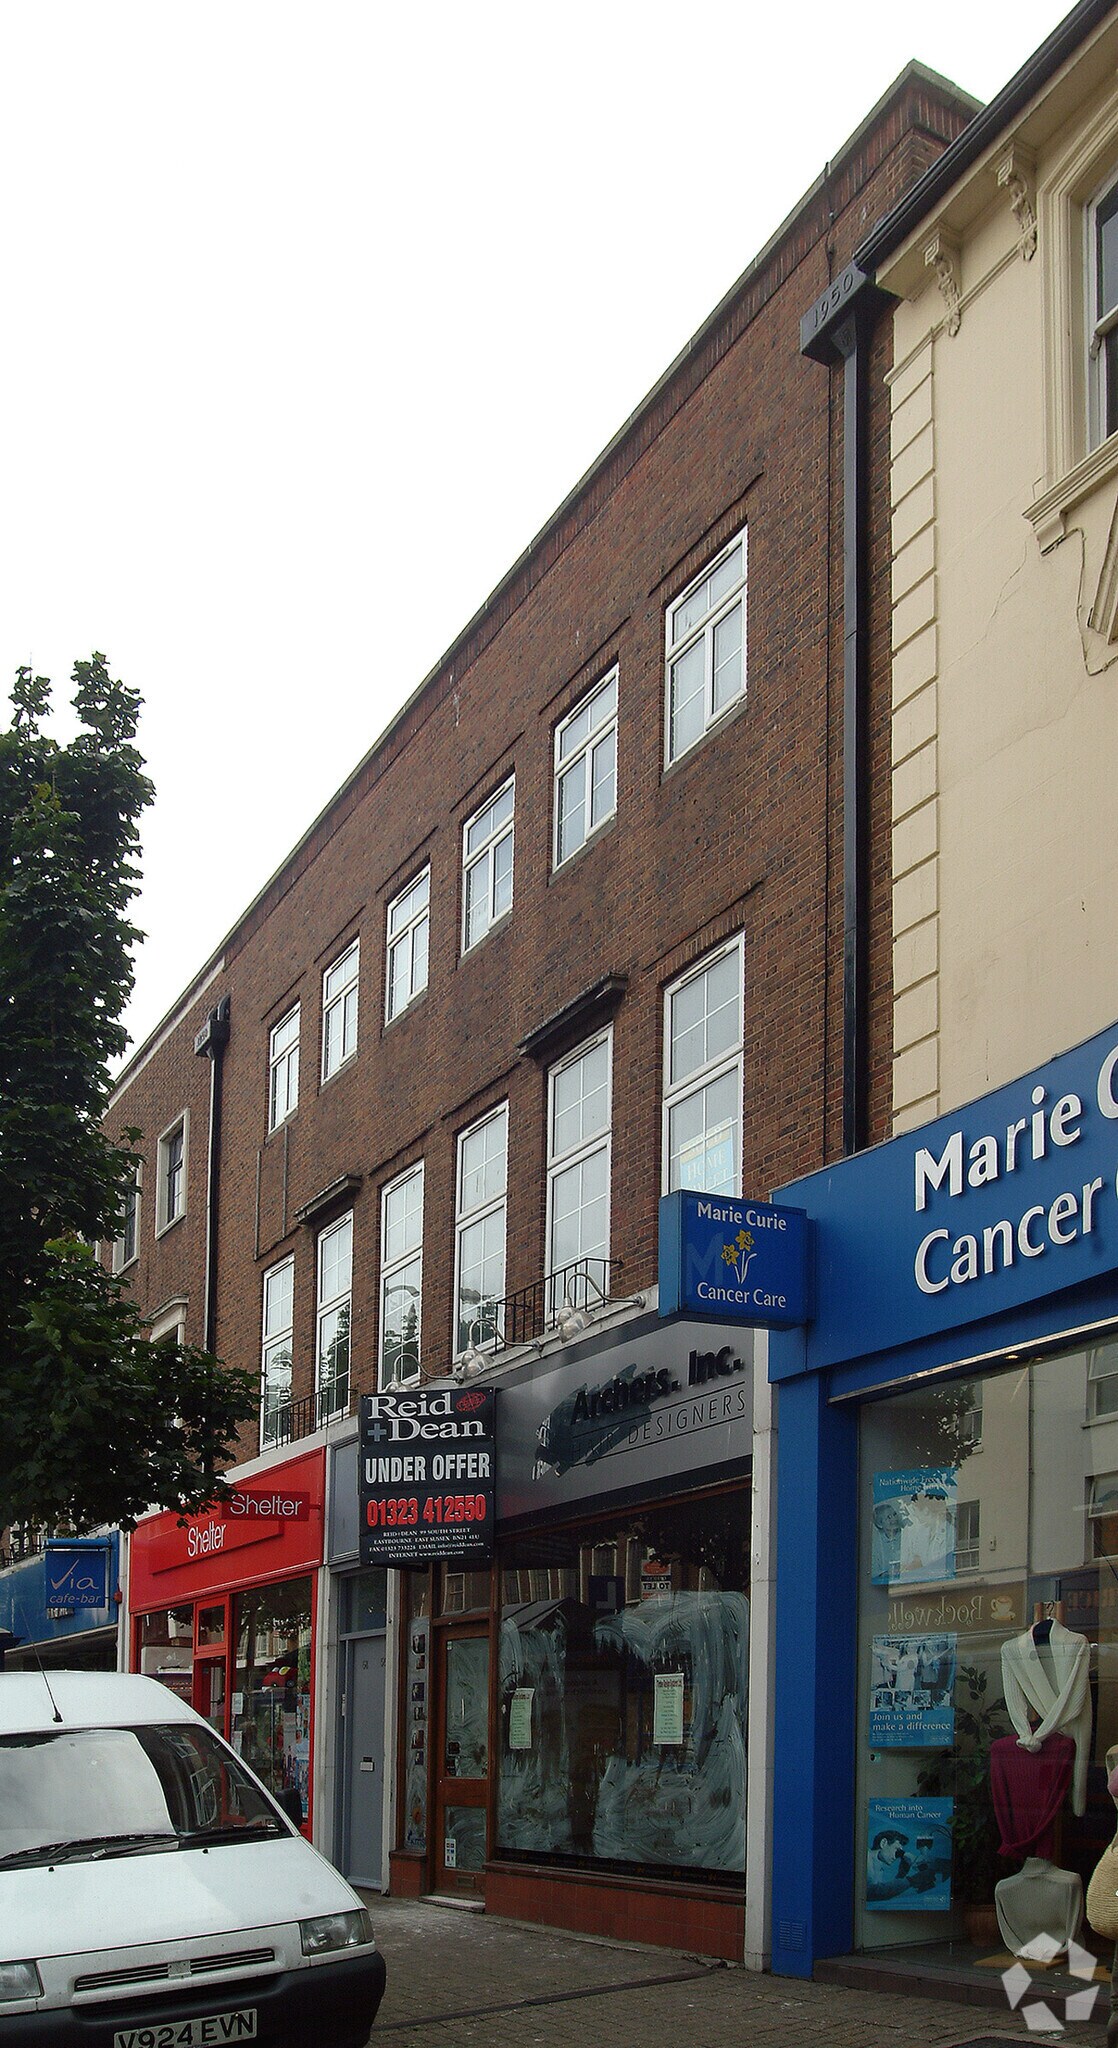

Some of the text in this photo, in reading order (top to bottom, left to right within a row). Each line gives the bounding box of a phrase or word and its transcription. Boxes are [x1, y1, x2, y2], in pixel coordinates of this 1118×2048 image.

[814, 273, 853, 328] 1950
[914, 1085, 1082, 1212] Marie
[697, 1201, 787, 1231] Marie Curie
[914, 1176, 1103, 1294] Cancer
[697, 1281, 787, 1308] Cancer Care
[687, 1345, 744, 1387] Inc.
[367, 1393, 455, 1419] Reid
[629, 1390, 746, 1444] DESIGNERS
[365, 1452, 490, 1484] UNDER OFFER
[230, 1494, 303, 1516] Shelter
[366, 1494, 487, 1527] 01323 412550
[187, 1520, 227, 1557] Shelter
[49, 1593, 101, 1604] cafe-bar
[872, 1712, 923, 1721] Join us and
[872, 1722, 896, 1731] make
[906, 1721, 951, 1730] difference
[875, 1803, 923, 1812] Research into
[889, 1811, 942, 1819] Human Cancer
[118, 2012, 253, 2048] V924 EVN
